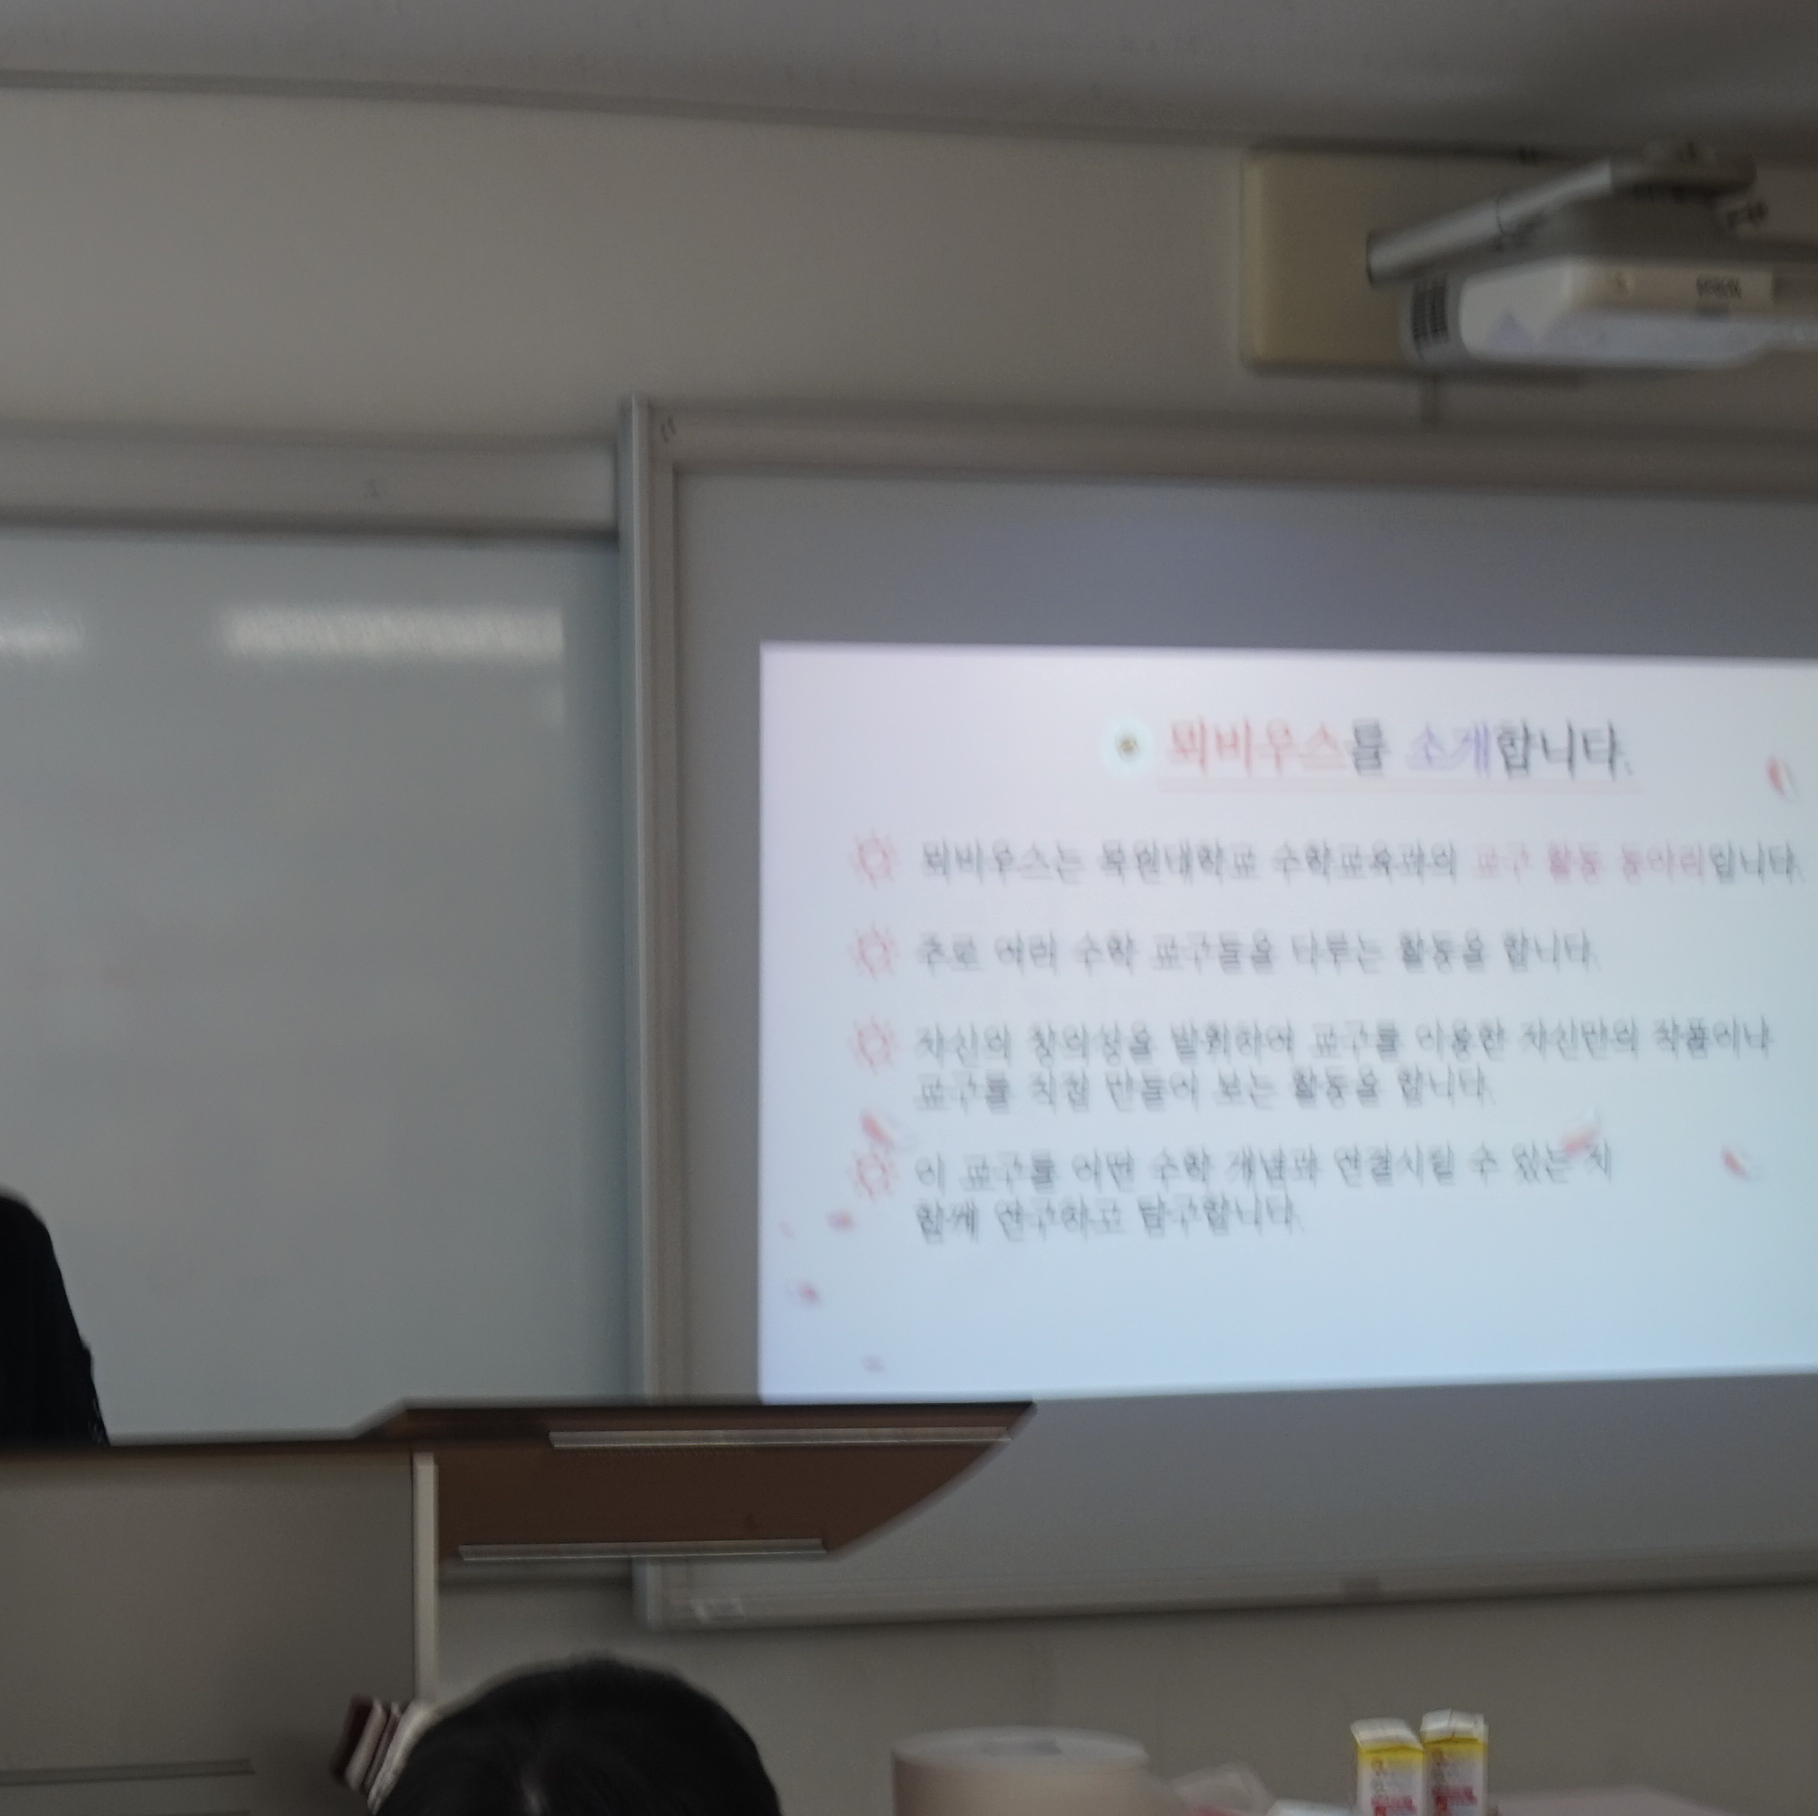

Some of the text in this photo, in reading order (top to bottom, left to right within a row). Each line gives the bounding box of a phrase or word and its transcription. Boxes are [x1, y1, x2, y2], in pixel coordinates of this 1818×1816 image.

[1170, 714, 1634, 781] 뫼비우스를 소개합니다.
[922, 837, 1081, 885] 뫼비우스는
[1099, 837, 1259, 885] 목원대학교
[1271, 837, 1458, 884] 수학교육과의
[1471, 838, 1531, 884] 교구
[1545, 838, 1603, 884] 활동
[915, 927, 1603, 977] 주로 여러 수학 교구들을 다루는 활동을 합니다.
[912, 1021, 1013, 1068] 자신의
[1028, 1019, 1155, 1067] 창의성을
[1169, 1018, 1297, 1064] 발휘하여
[1311, 1017, 1402, 1061] 교구를
[1415, 1015, 1506, 1062] 이용한
[1519, 1015, 1641, 1061] 자신만의
[912, 1062, 1495, 1115] 교구를 직접 만들어 보는 활동을 합니다.
[914, 1150, 947, 1196] 이
[960, 1148, 1056, 1194] 교구를
[1071, 1147, 1137, 1193] 어떤
[1148, 1144, 1212, 1192] 수학
[1224, 1143, 1323, 1191] 개념과
[1333, 1140, 1457, 1187] 연결시킬
[1470, 1141, 1503, 1187] 수
[913, 1195, 980, 1244] 함께
[993, 1195, 1125, 1243] 연구하고
